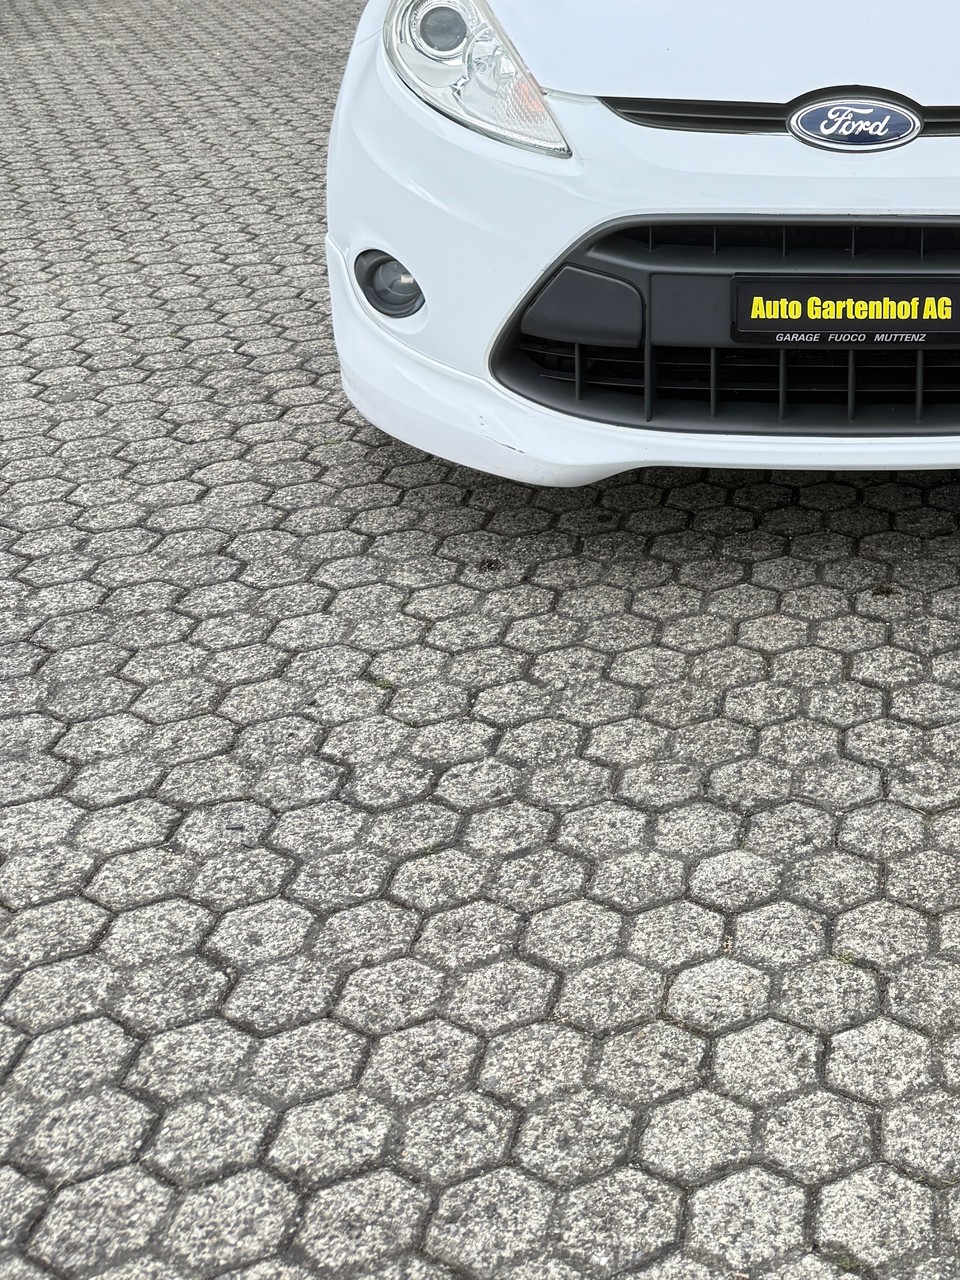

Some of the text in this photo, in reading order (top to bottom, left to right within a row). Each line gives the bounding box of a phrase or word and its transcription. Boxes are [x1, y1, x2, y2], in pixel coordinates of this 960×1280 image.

[819, 106, 890, 136] Ford
[751, 296, 953, 320] Auto Gartenhof AG
[775, 332, 927, 343] GARAGE FUOCO MUTTENZ
